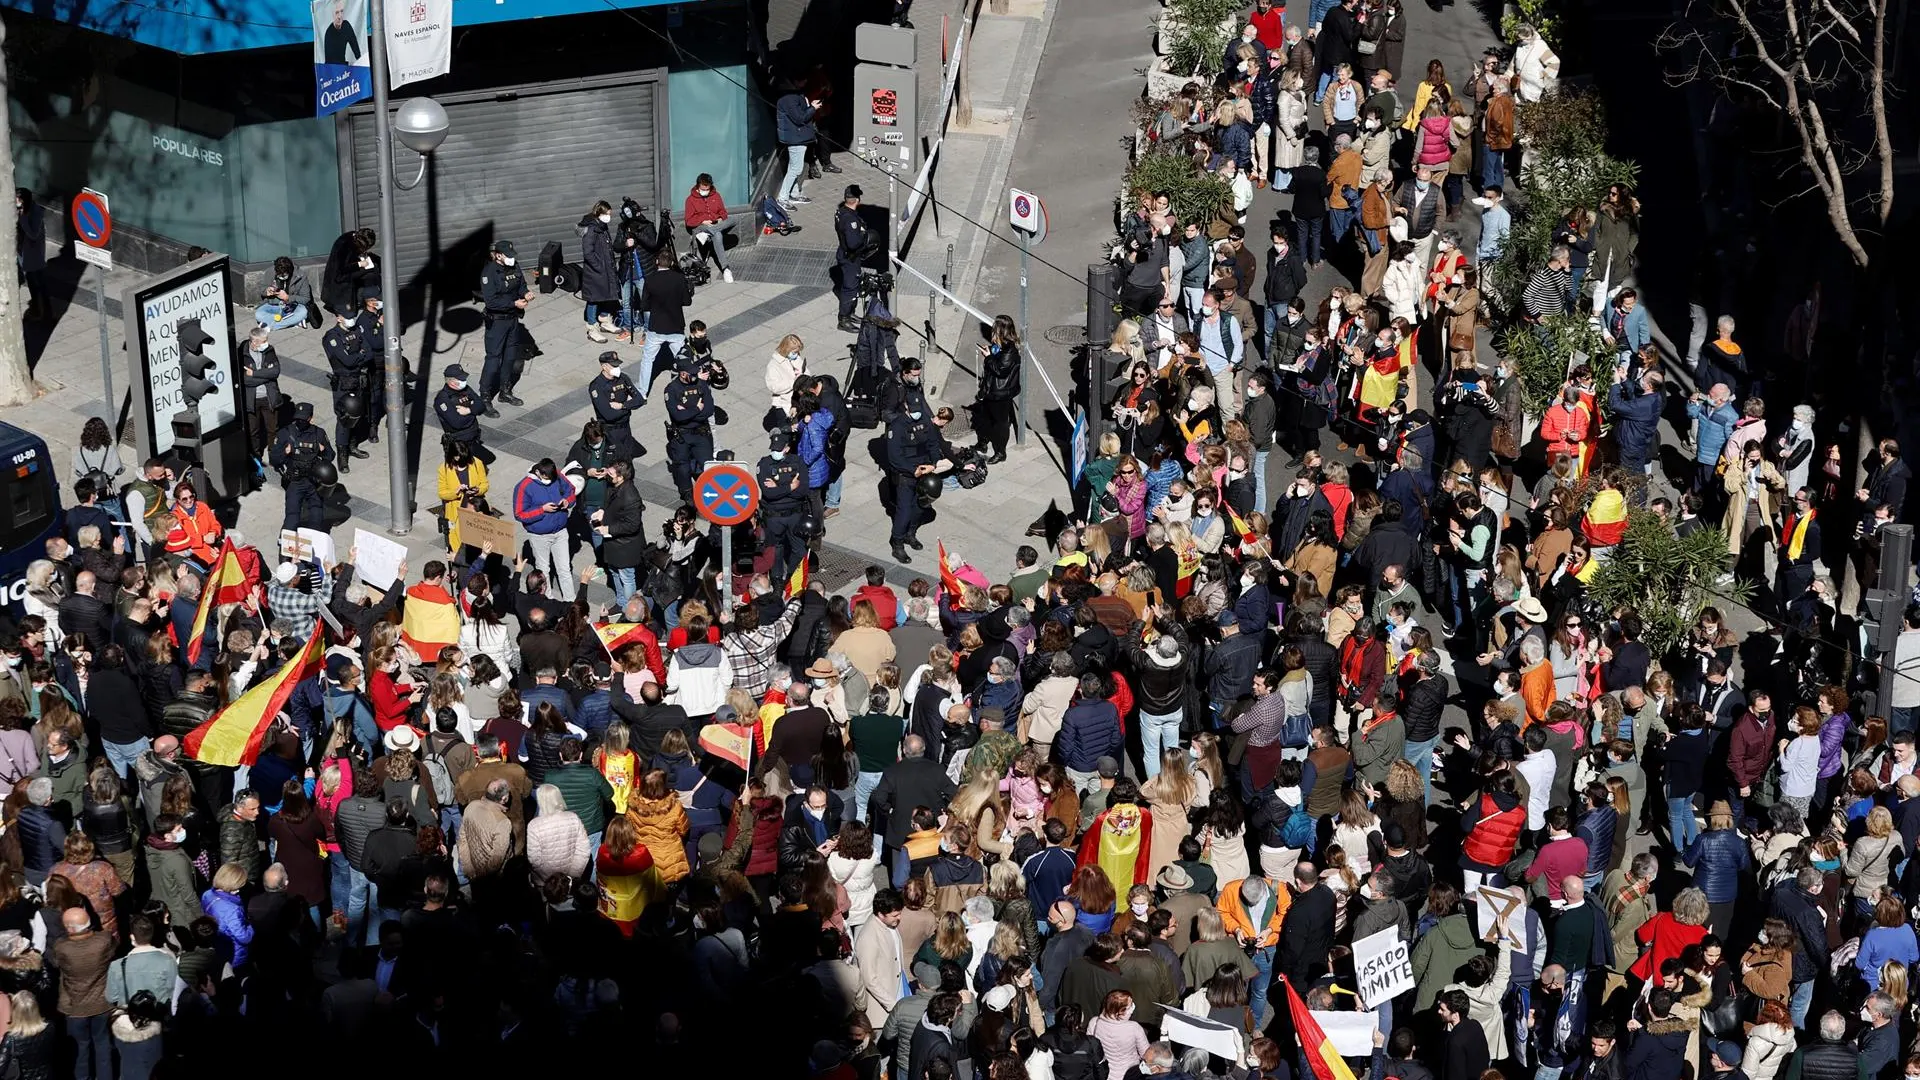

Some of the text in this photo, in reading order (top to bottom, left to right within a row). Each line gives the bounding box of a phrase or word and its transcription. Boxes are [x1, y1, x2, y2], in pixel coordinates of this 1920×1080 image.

[394, 23, 440, 39] NAVES ESPAÑOL
[408, 67, 434, 78] MADRID
[320, 79, 360, 107] Oceanía
[152, 135, 223, 166] POPULARES
[145, 279, 219, 321] AYUDAMOS
[148, 330, 157, 345] A
[150, 344, 179, 368] MEN
[154, 393, 171, 413] EN
[12, 449, 36, 465] 1U-80
